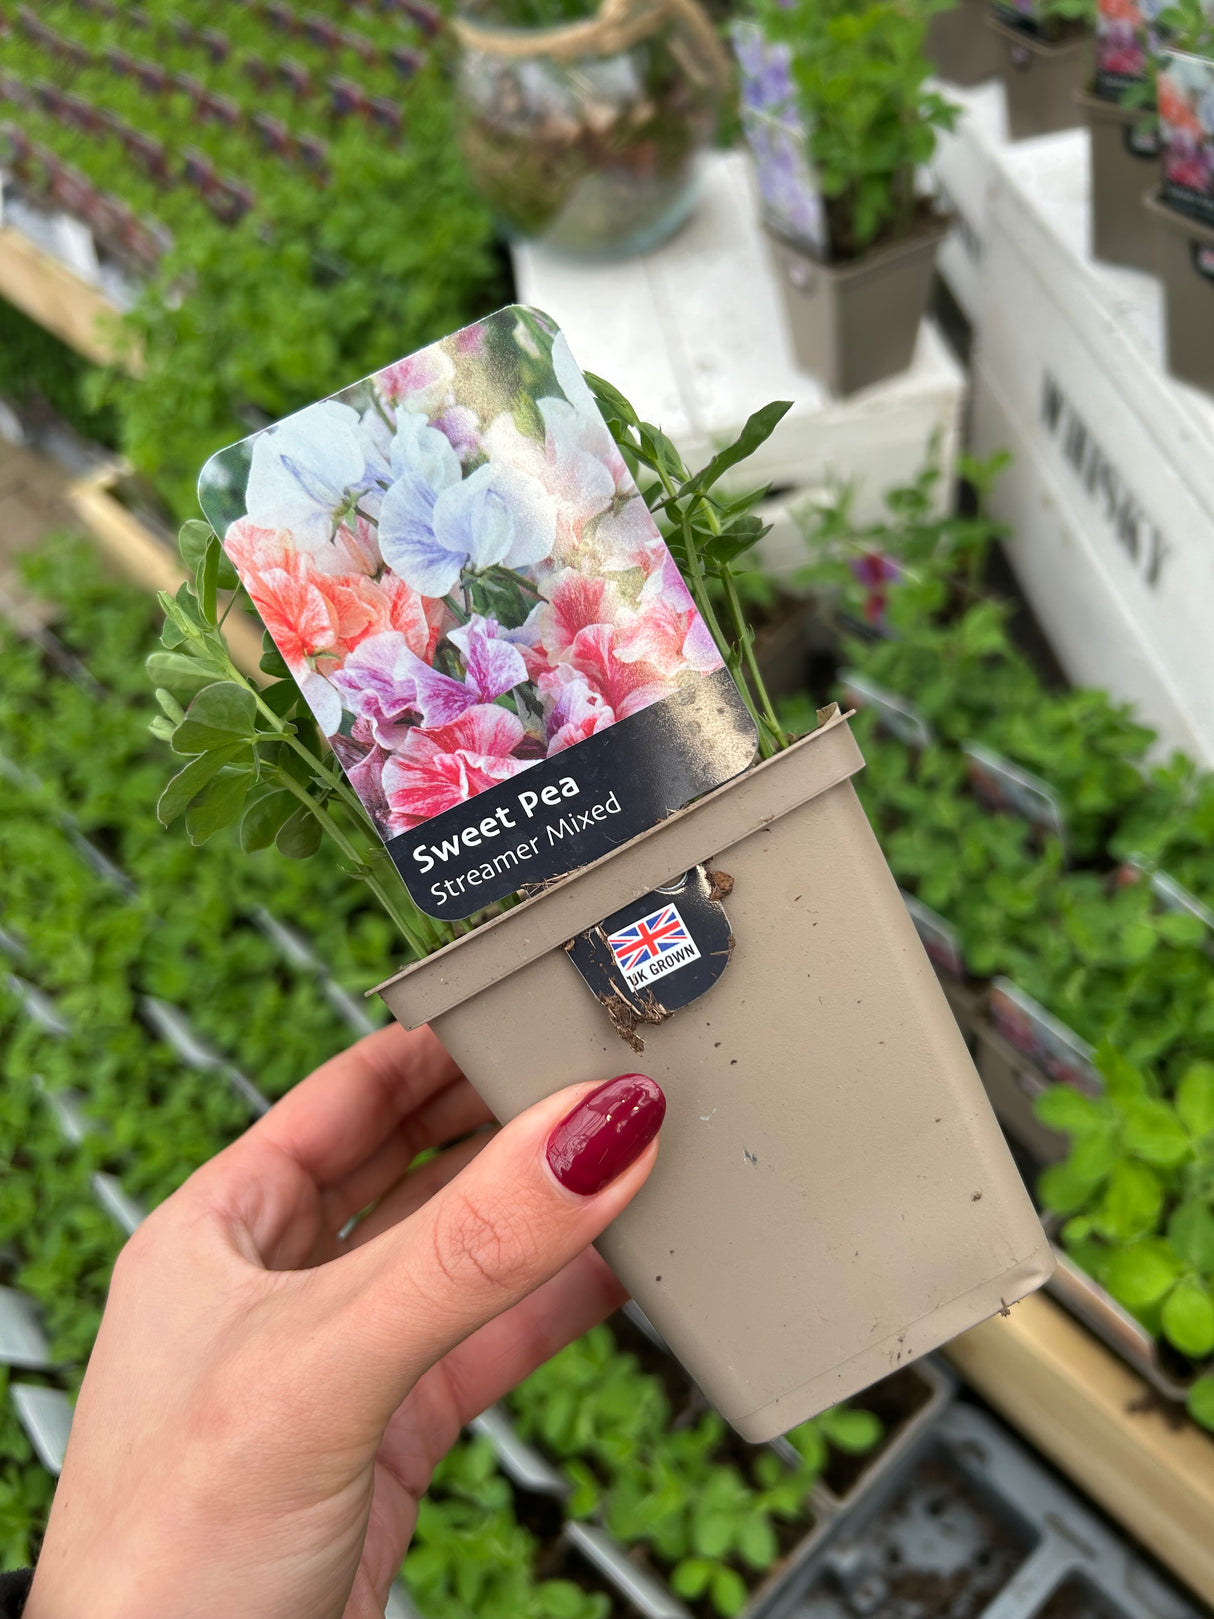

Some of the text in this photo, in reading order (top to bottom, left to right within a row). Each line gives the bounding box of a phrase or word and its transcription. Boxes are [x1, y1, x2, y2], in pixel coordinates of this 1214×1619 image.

[412, 776, 580, 874] Sweet Pea
[430, 791, 622, 906] Streamer Mixed
[626, 944, 696, 987] UK GROWN
